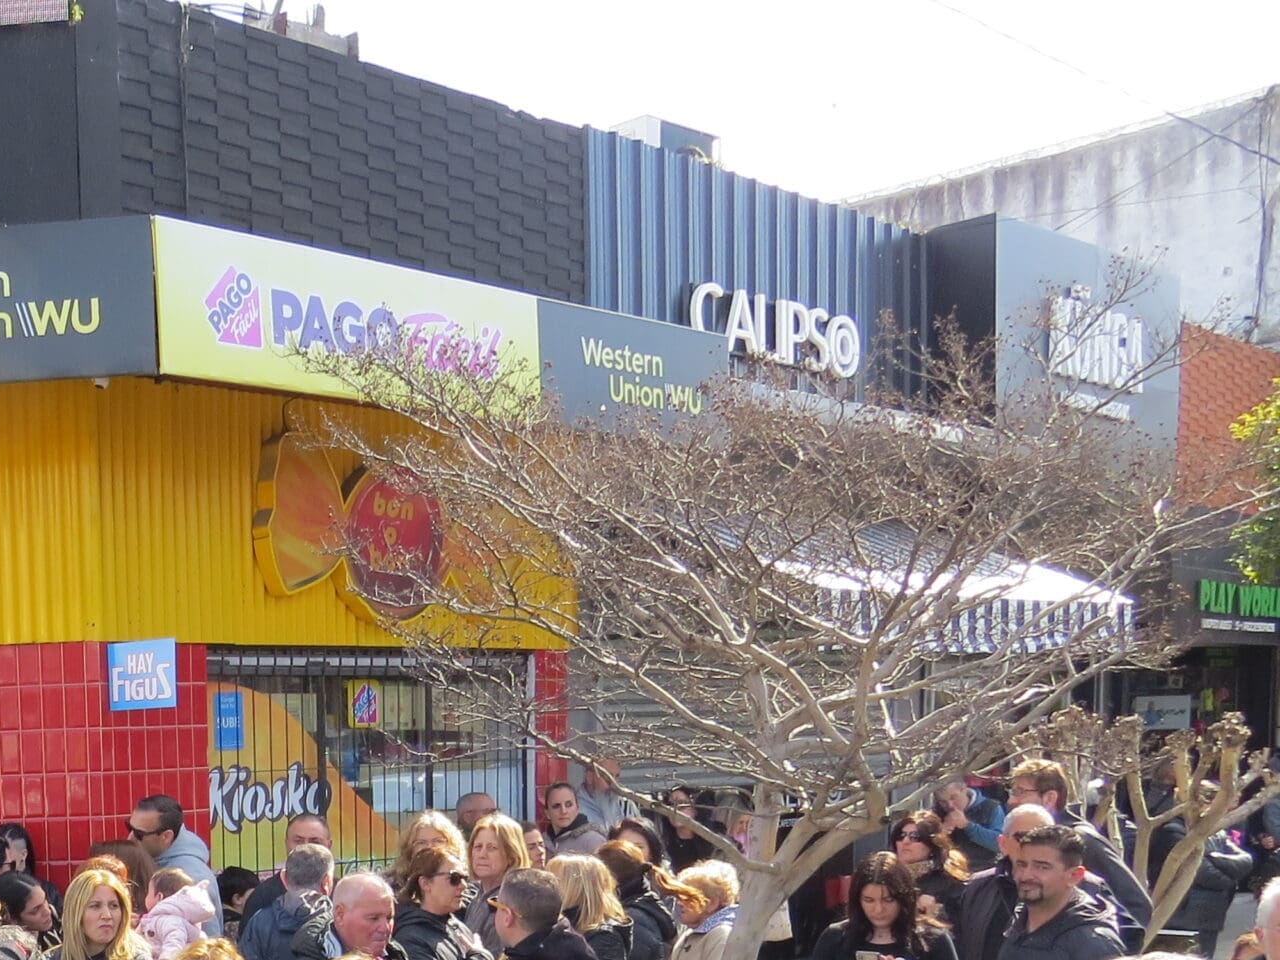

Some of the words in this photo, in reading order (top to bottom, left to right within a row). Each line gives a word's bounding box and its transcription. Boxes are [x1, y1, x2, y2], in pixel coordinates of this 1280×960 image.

[208, 272, 252, 333] PAGO
[271, 288, 401, 357] PAGO
[581, 336, 663, 377] Western
[609, 373, 664, 410] Union
[373, 491, 415, 521] bon
[1200, 579, 1237, 614] PLAY
[1239, 584, 1280, 618] WORL
[127, 652, 155, 675] HAY
[209, 763, 331, 832] Kiosko
